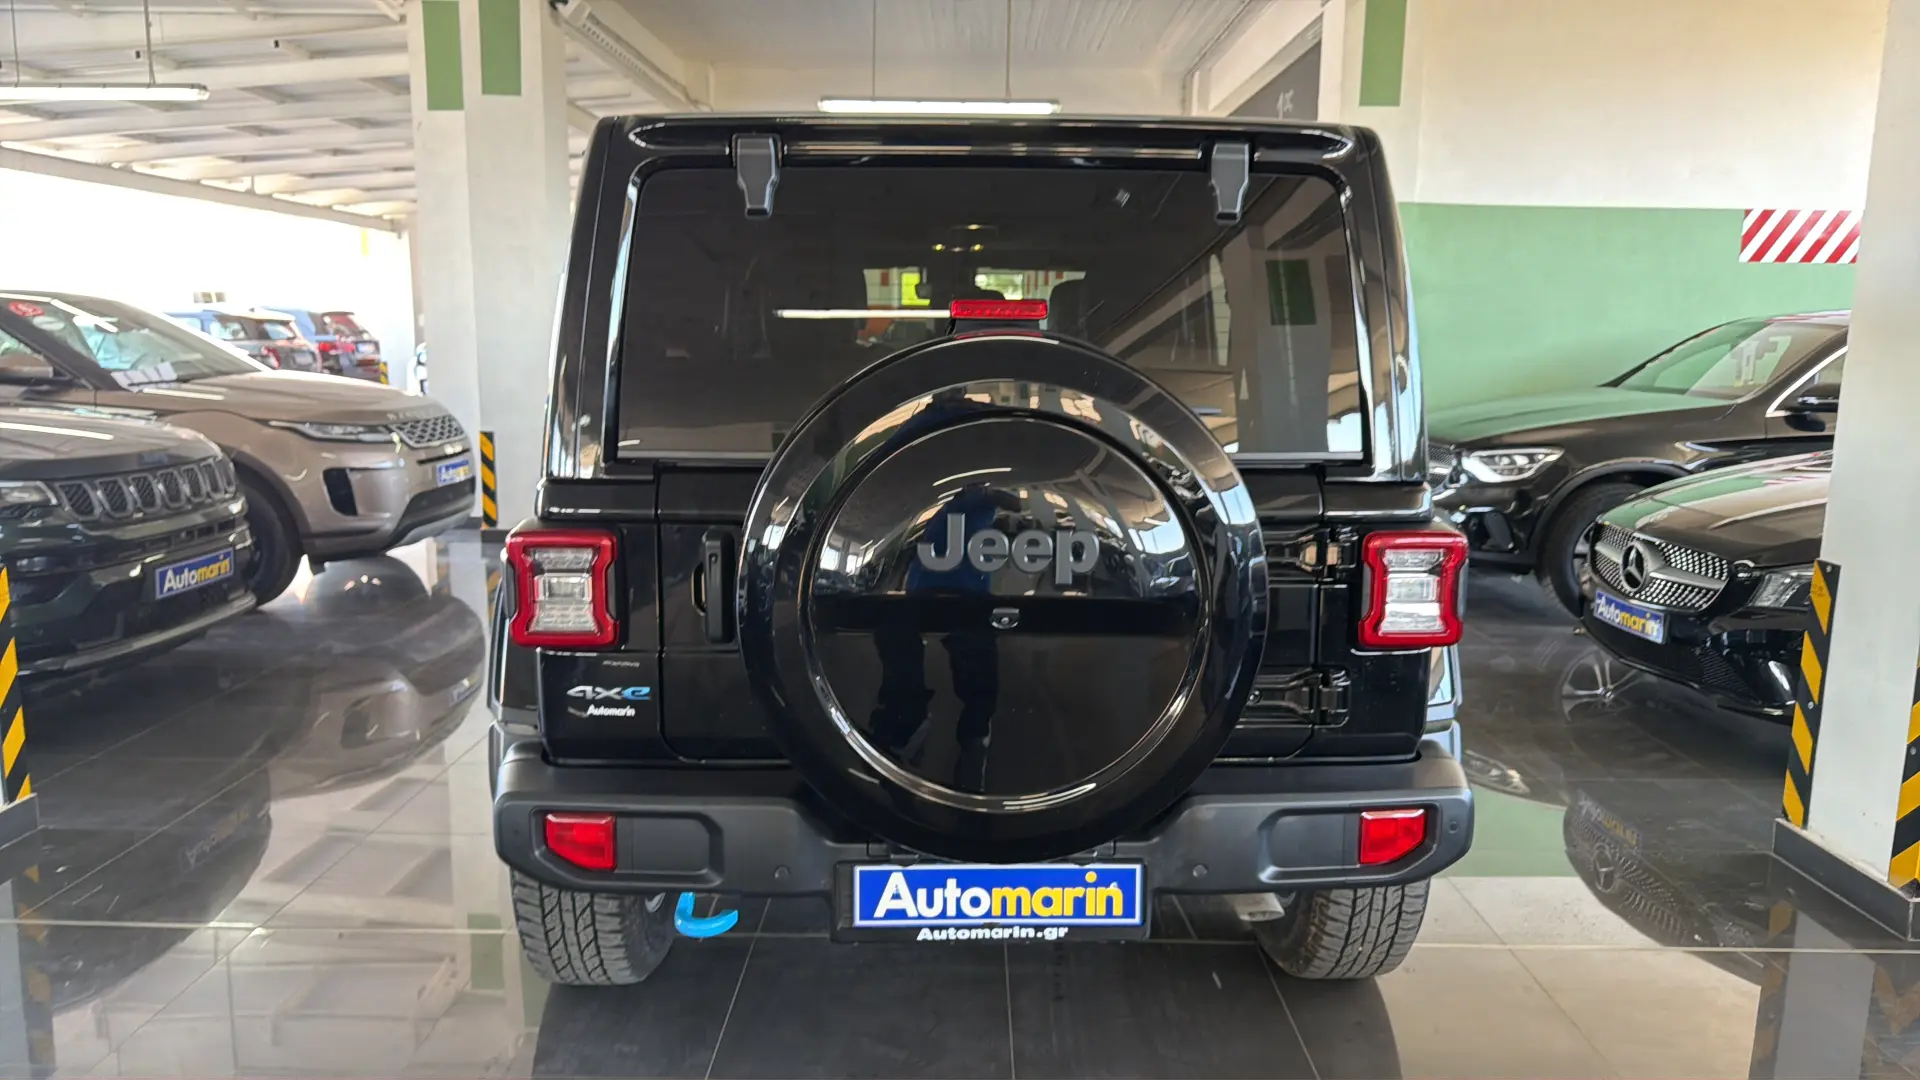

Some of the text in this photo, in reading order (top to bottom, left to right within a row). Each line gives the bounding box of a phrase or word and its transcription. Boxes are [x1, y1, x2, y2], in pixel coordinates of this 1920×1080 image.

[917, 513, 1100, 585] Jeep
[163, 554, 230, 593] Automarin
[1597, 595, 1659, 636] Automarin
[587, 704, 636, 717] Automarin
[873, 871, 1123, 918] Automarin
[916, 925, 1069, 941] Automarin.gr
